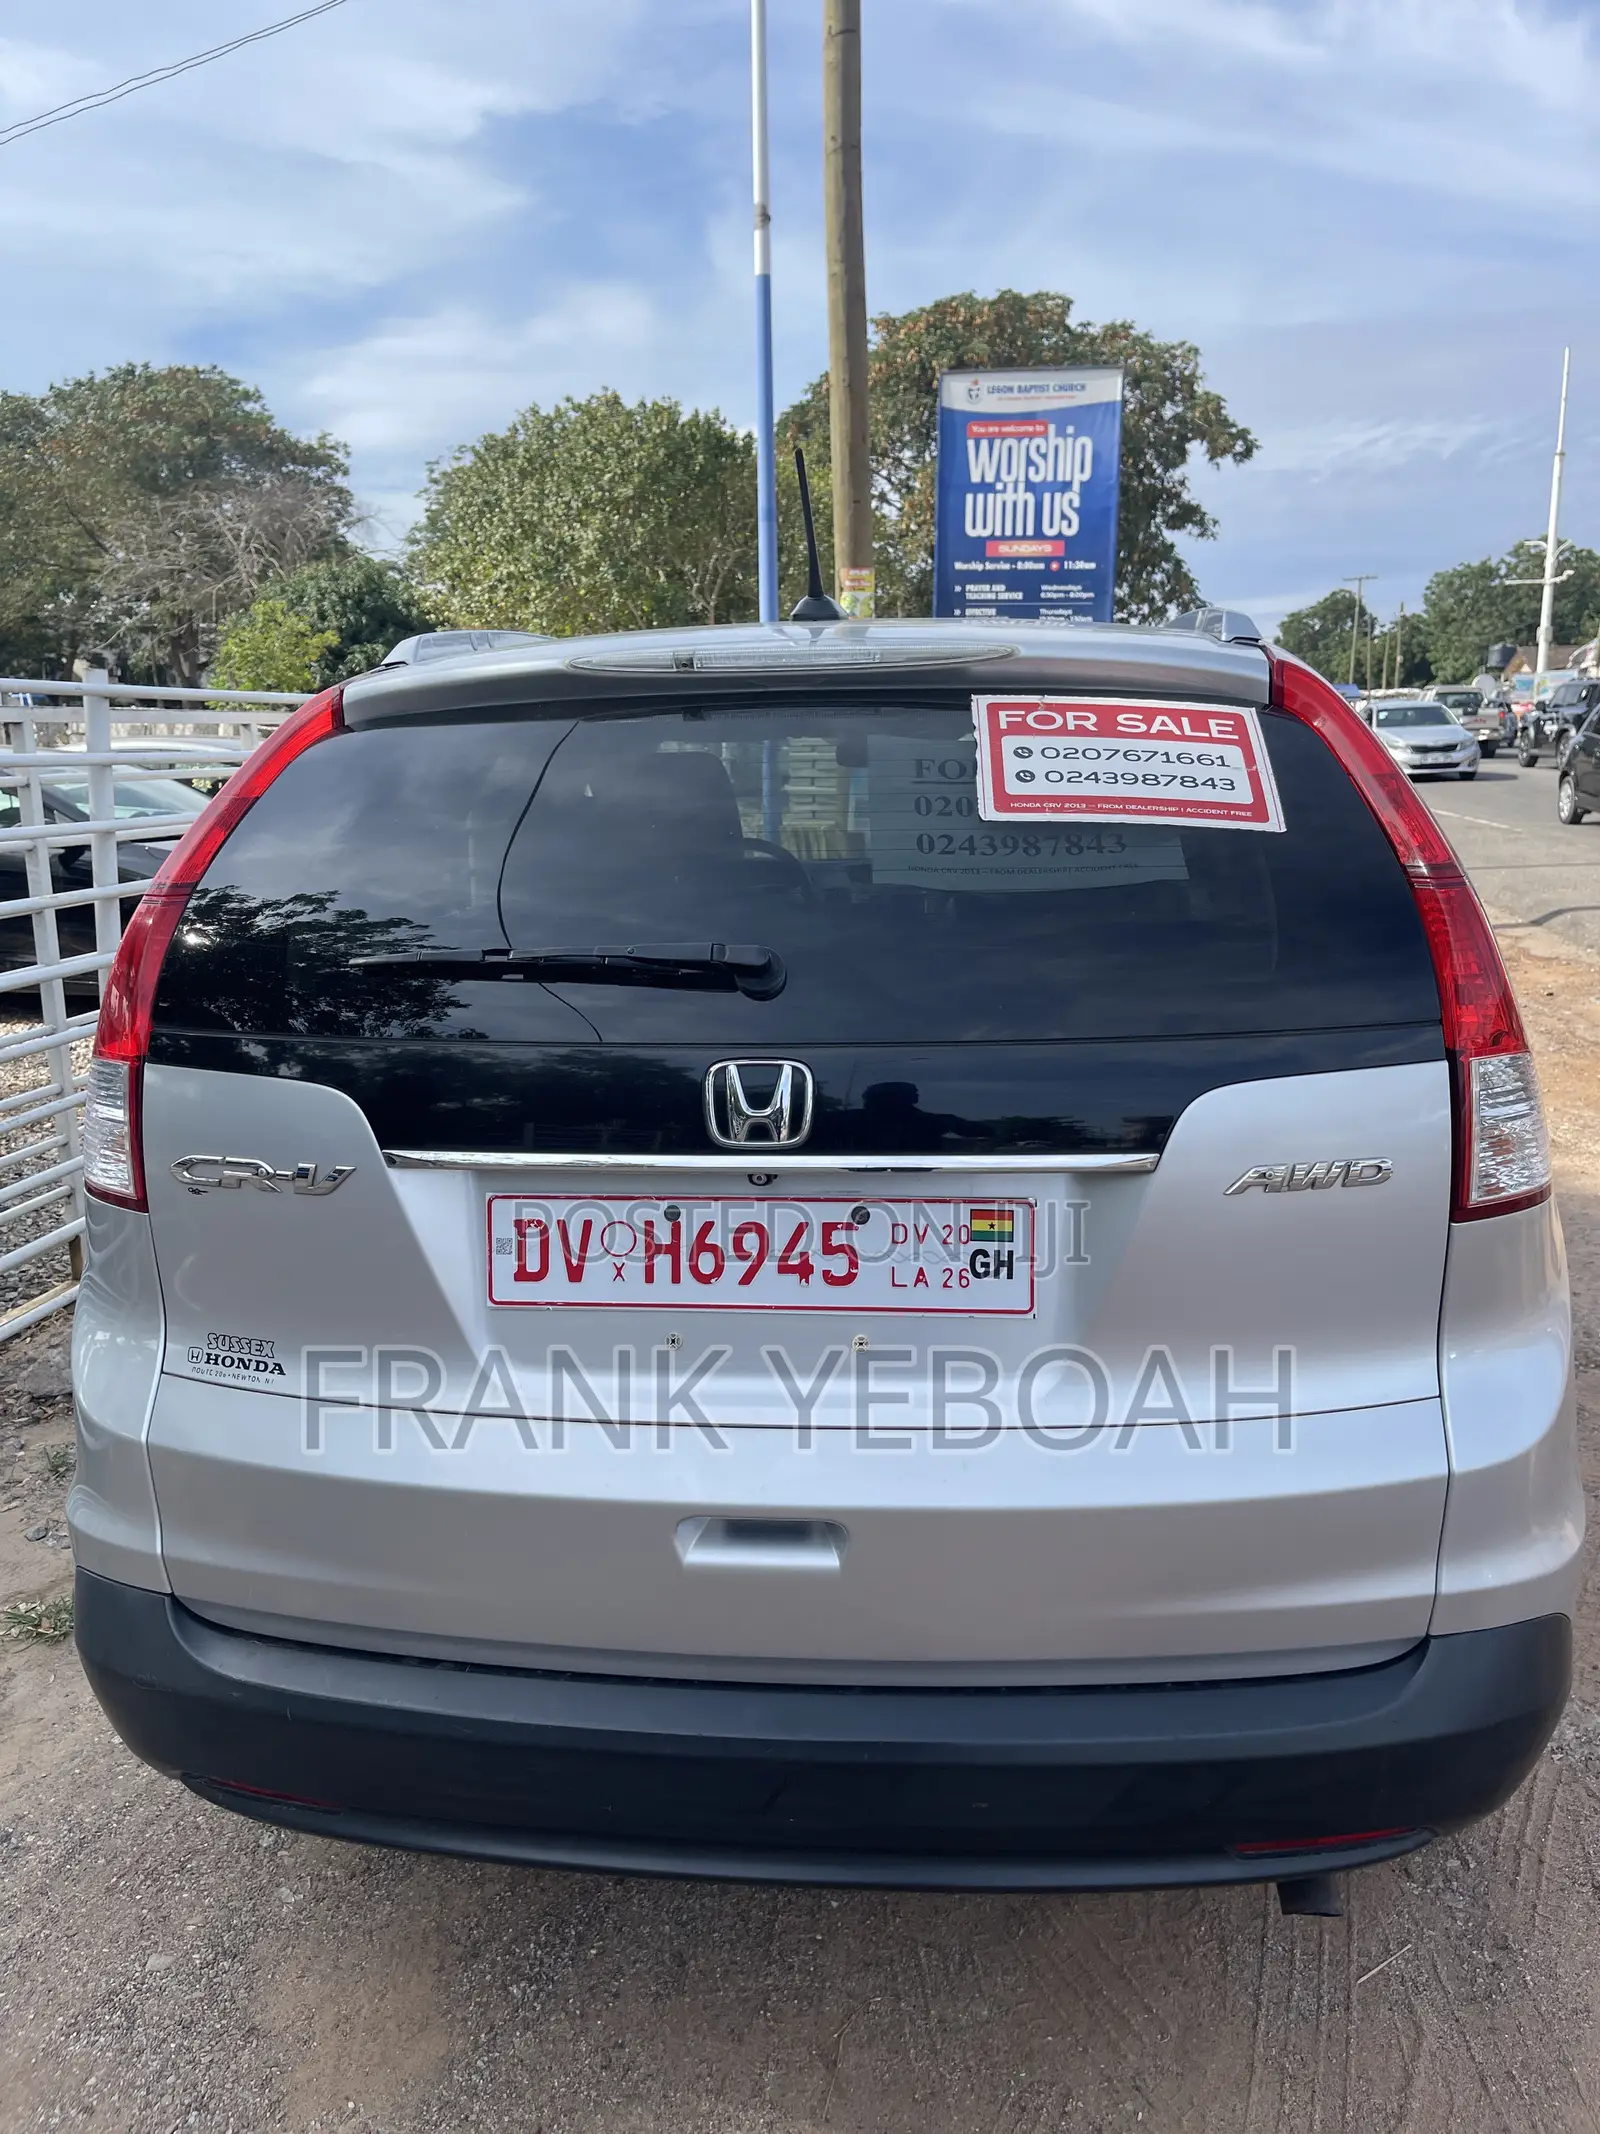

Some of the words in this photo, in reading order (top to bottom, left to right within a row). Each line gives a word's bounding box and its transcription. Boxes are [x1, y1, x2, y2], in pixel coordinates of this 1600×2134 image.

[1017, 384, 1049, 394] BAPTIST
[1053, 383, 1086, 392] CHURCH
[965, 482, 1035, 537] with
[1042, 491, 1079, 537] us
[998, 544, 1052, 553] SUNDAYS
[954, 561, 984, 571] Worship
[984, 561, 1010, 570] Service
[998, 592, 1023, 600] SERVICE
[998, 710, 1099, 732] FOR
[1116, 714, 1240, 739] SALE
[1040, 746, 1231, 768] 0207671661
[914, 759, 976, 780] FO
[1044, 770, 1236, 791] 0243987843
[916, 833, 1127, 857] 0243987843
[908, 865, 939, 874] HONDA
[989, 868, 1013, 876] FROM
[171, 1155, 357, 1195] CR-V
[1223, 1157, 1393, 1195] AWD
[891, 1223, 929, 1245] DV
[942, 1224, 970, 1246] 20
[513, 1218, 593, 1282] DV
[644, 1220, 859, 1286] H6945
[969, 1249, 1014, 1280] GH
[891, 1266, 928, 1288] LA
[942, 1268, 970, 1289] 26
[207, 1333, 275, 1358] SUSSEX
[204, 1352, 286, 1376] HONDA
[231, 1374, 260, 1383] NEWTON
